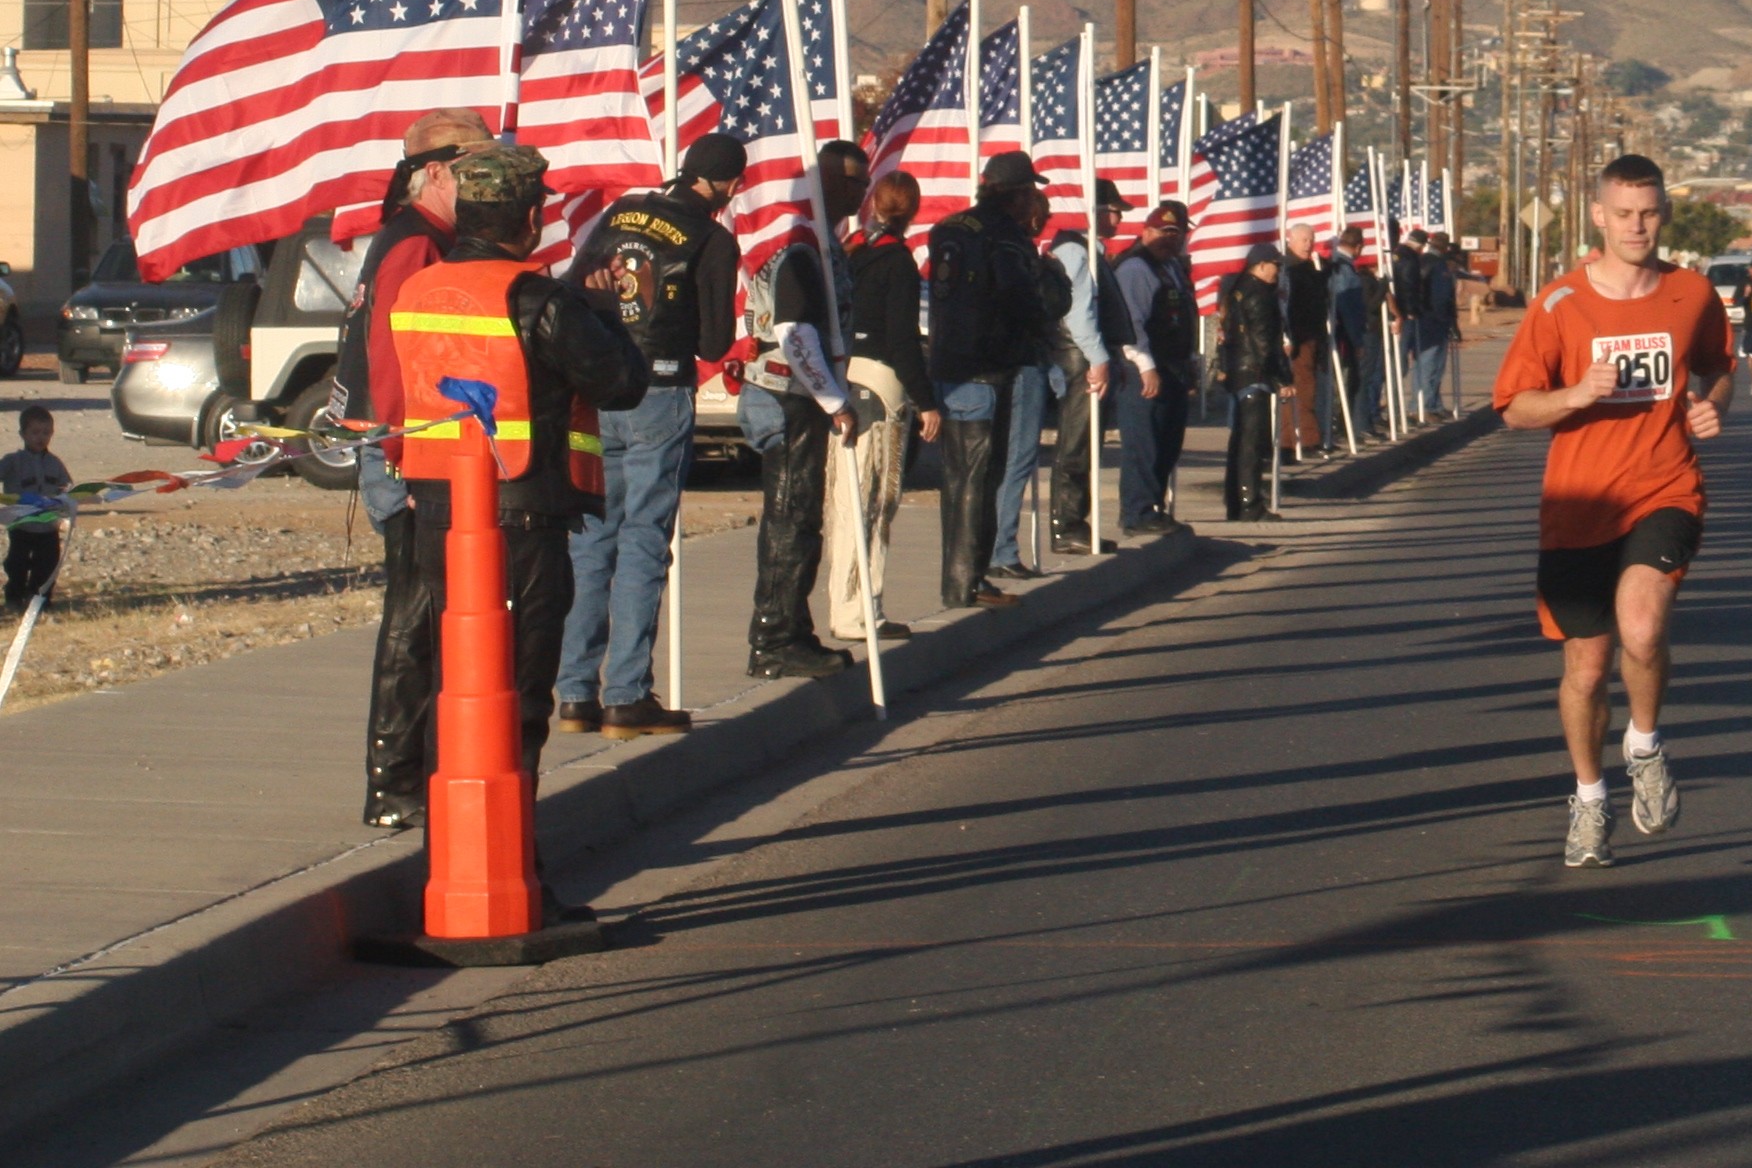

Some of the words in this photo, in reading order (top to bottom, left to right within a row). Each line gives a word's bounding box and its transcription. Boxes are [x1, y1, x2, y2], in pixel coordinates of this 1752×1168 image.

[650, 217, 688, 246] RIDERS
[1598, 339, 1631, 352] TEAM
[1634, 337, 1666, 350] BLISS
[702, 391, 727, 402] Jeep
